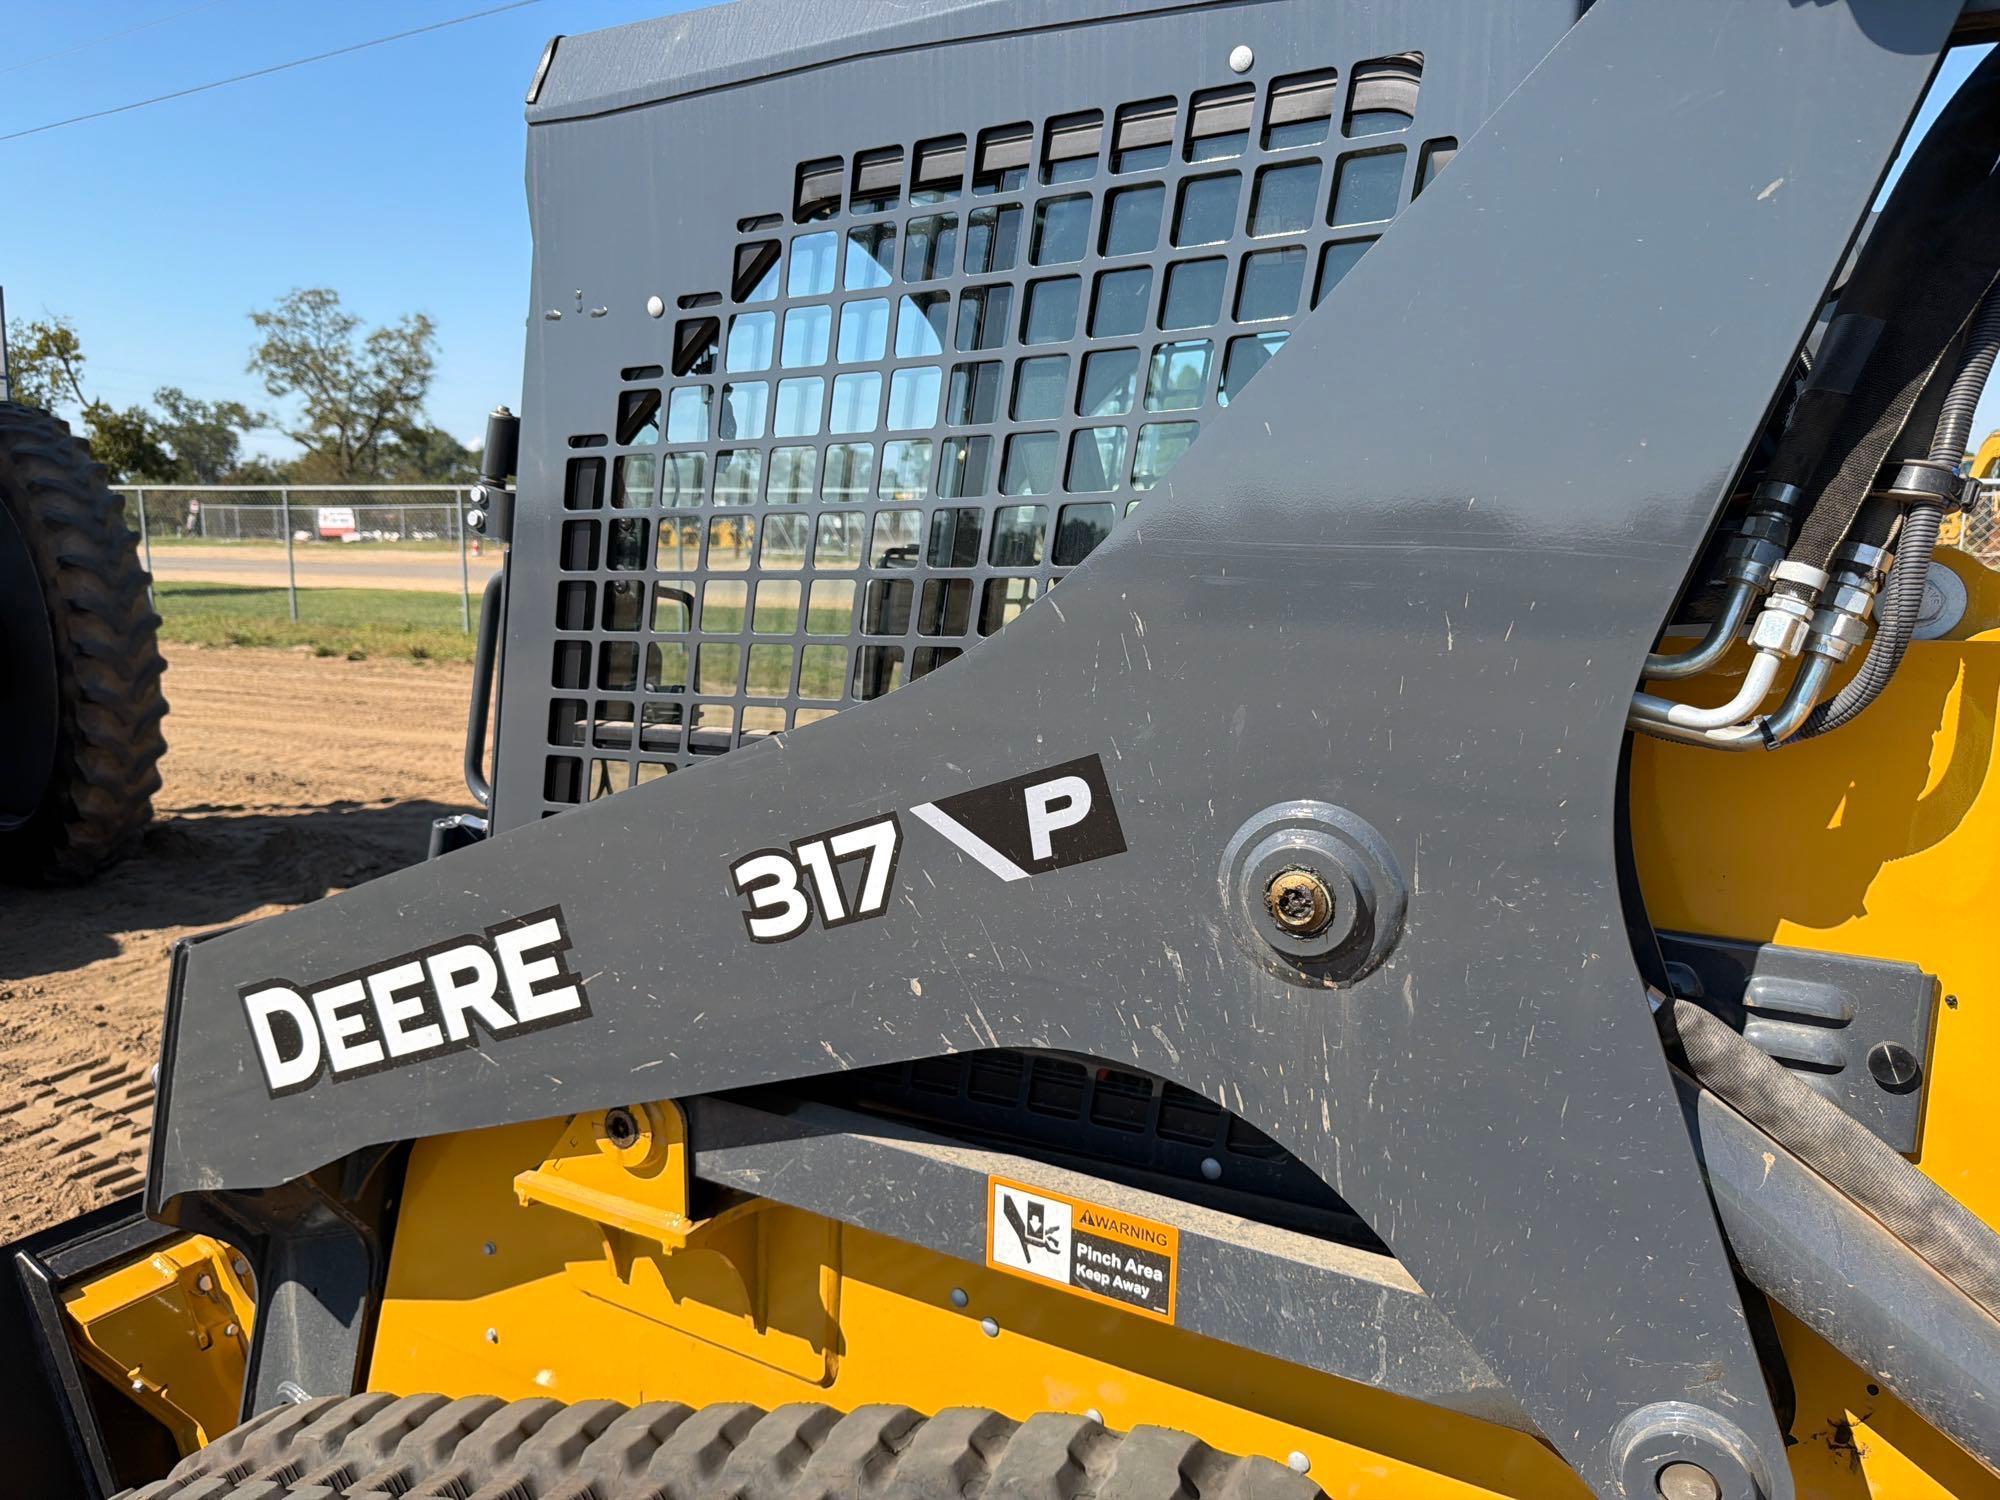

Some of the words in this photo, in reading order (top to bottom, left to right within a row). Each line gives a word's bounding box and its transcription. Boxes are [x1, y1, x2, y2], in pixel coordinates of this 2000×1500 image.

[735, 820, 897, 938] 317
[1023, 775, 1092, 861] P
[244, 917, 582, 1089] DEERE
[1095, 1214, 1168, 1247] WARNING
[1075, 1262, 1111, 1286] Keep
[1112, 1274, 1150, 1299] Away
[1076, 1242, 1121, 1270] Pinch
[1124, 1258, 1163, 1282] Area
